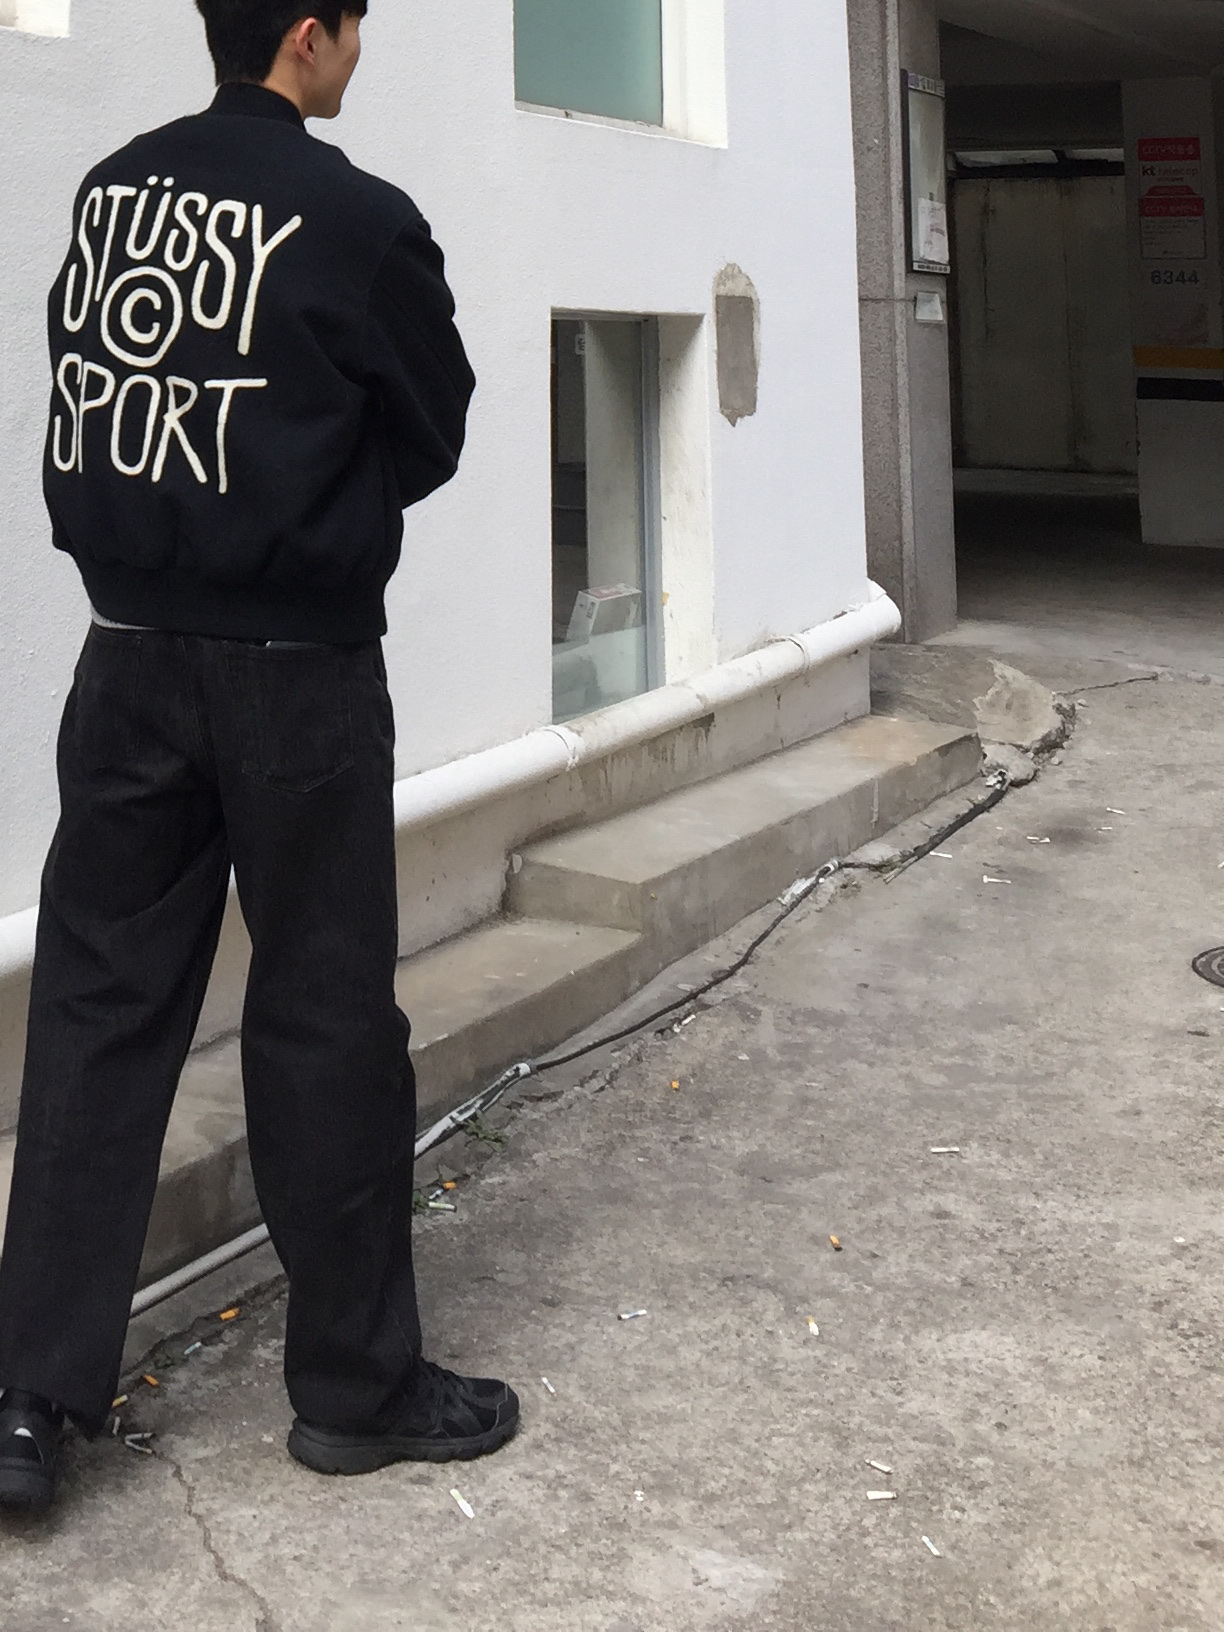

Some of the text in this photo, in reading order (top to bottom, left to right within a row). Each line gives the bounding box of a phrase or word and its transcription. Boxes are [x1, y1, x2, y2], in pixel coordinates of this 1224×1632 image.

[1142, 165, 1156, 177] kt
[63, 175, 302, 356] STÜSSY
[1150, 270, 1200, 285] 6344
[53, 352, 268, 494] SPORT
